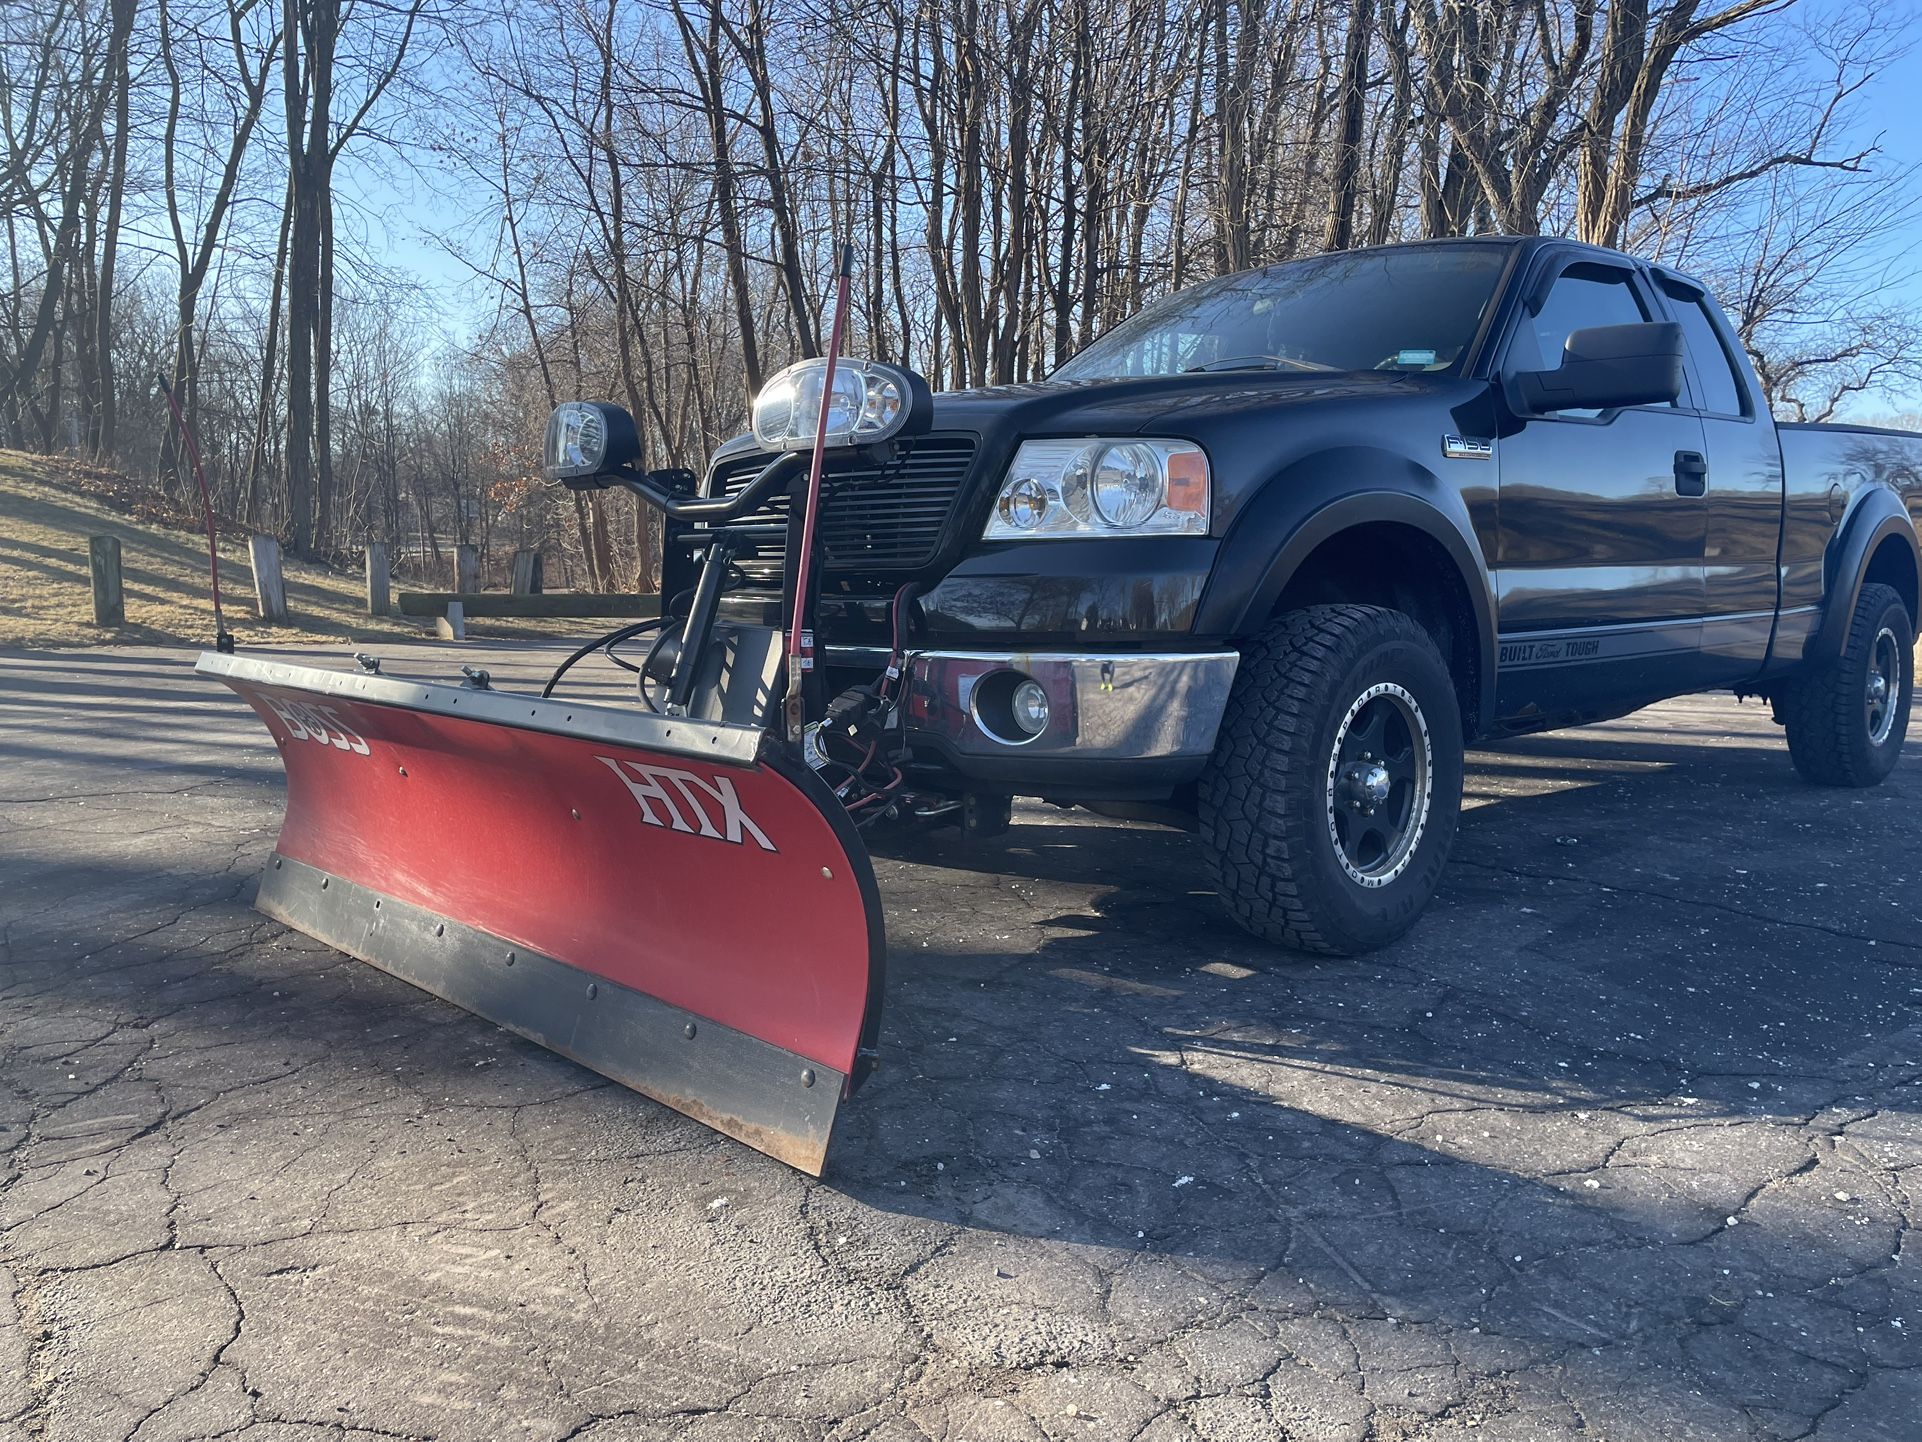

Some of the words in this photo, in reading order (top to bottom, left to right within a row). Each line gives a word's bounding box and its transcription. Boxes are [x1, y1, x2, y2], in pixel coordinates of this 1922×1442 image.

[1500, 644, 1535, 662] BUILT
[1535, 643, 1562, 659] Ford
[1565, 640, 1600, 657] TOUGH
[254, 691, 371, 756] BOSS
[593, 755, 778, 852] HTX
